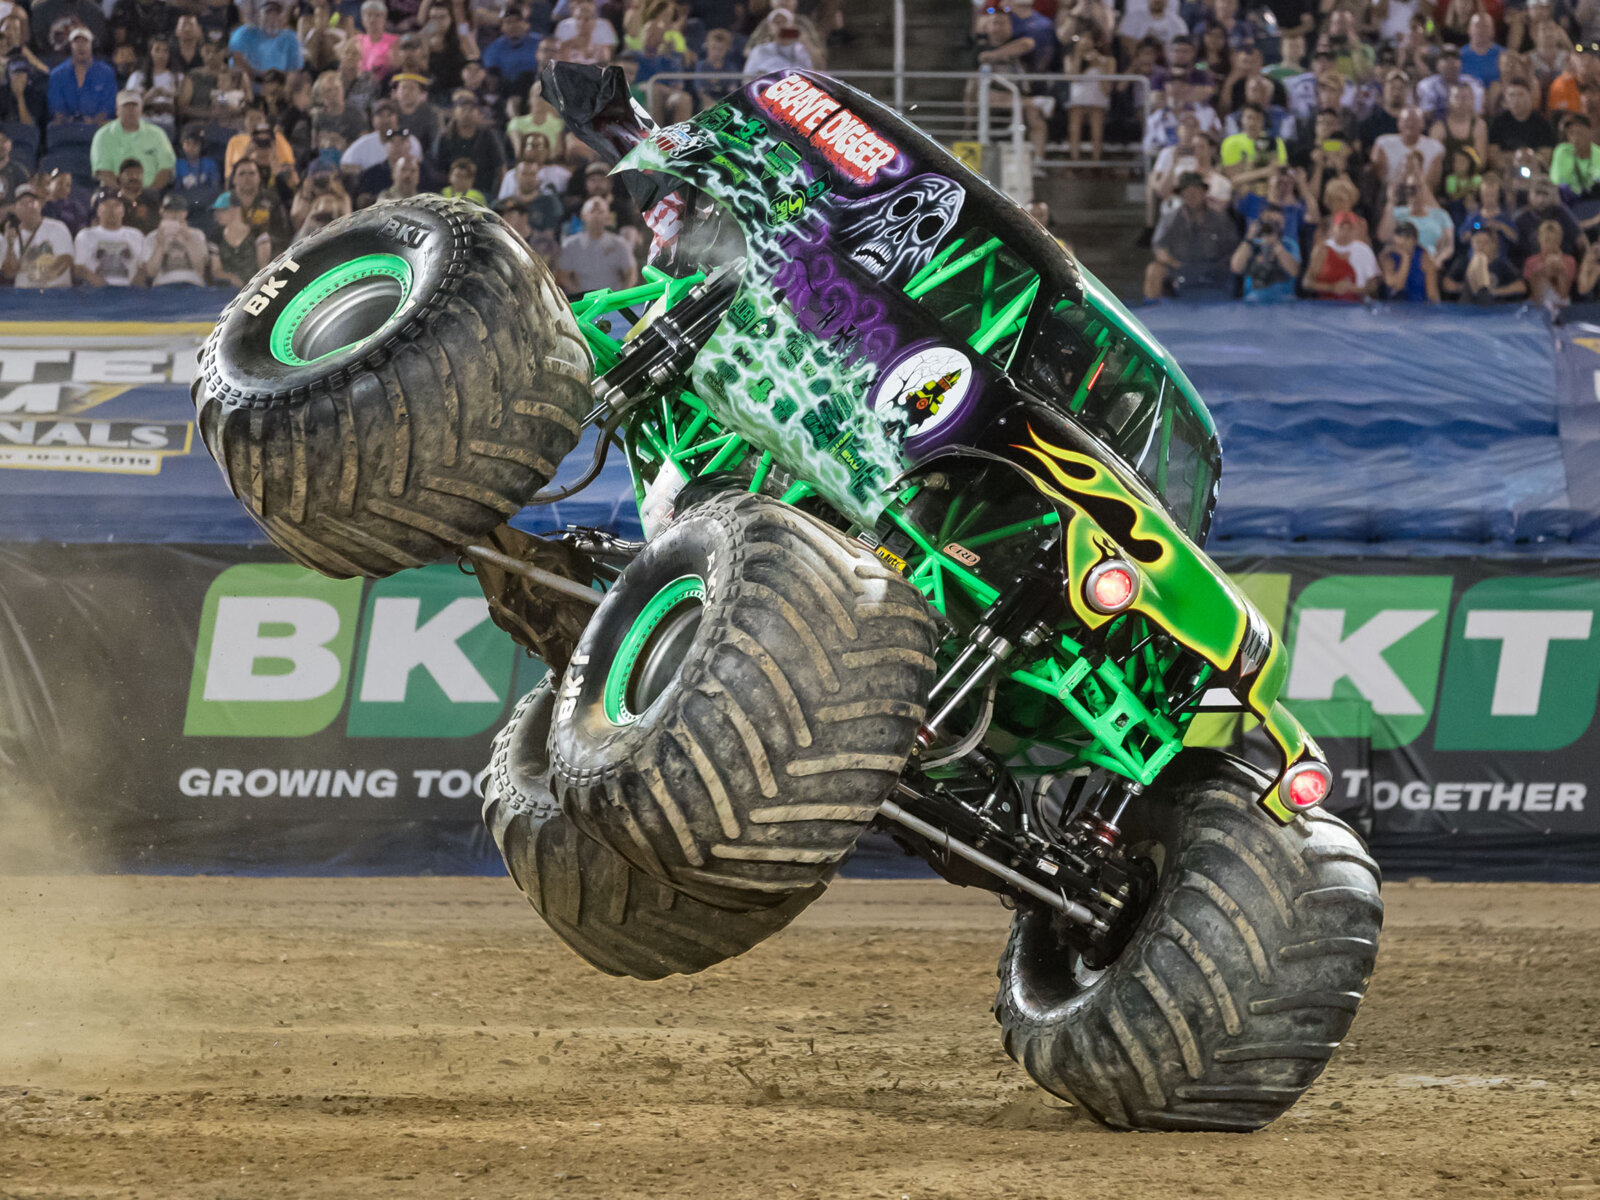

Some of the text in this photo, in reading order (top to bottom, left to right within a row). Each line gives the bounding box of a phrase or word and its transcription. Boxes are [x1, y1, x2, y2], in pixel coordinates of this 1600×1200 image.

[764, 73, 841, 129] GRAVE
[815, 108, 896, 175] DIGGER
[378, 216, 433, 249] BKT
[243, 256, 300, 317] BKT
[202, 596, 500, 703] BK
[1200, 609, 1593, 716] KT
[557, 650, 590, 722] BKT
[178, 768, 399, 798] GROWING
[1341, 769, 1588, 812] TOGETHER
